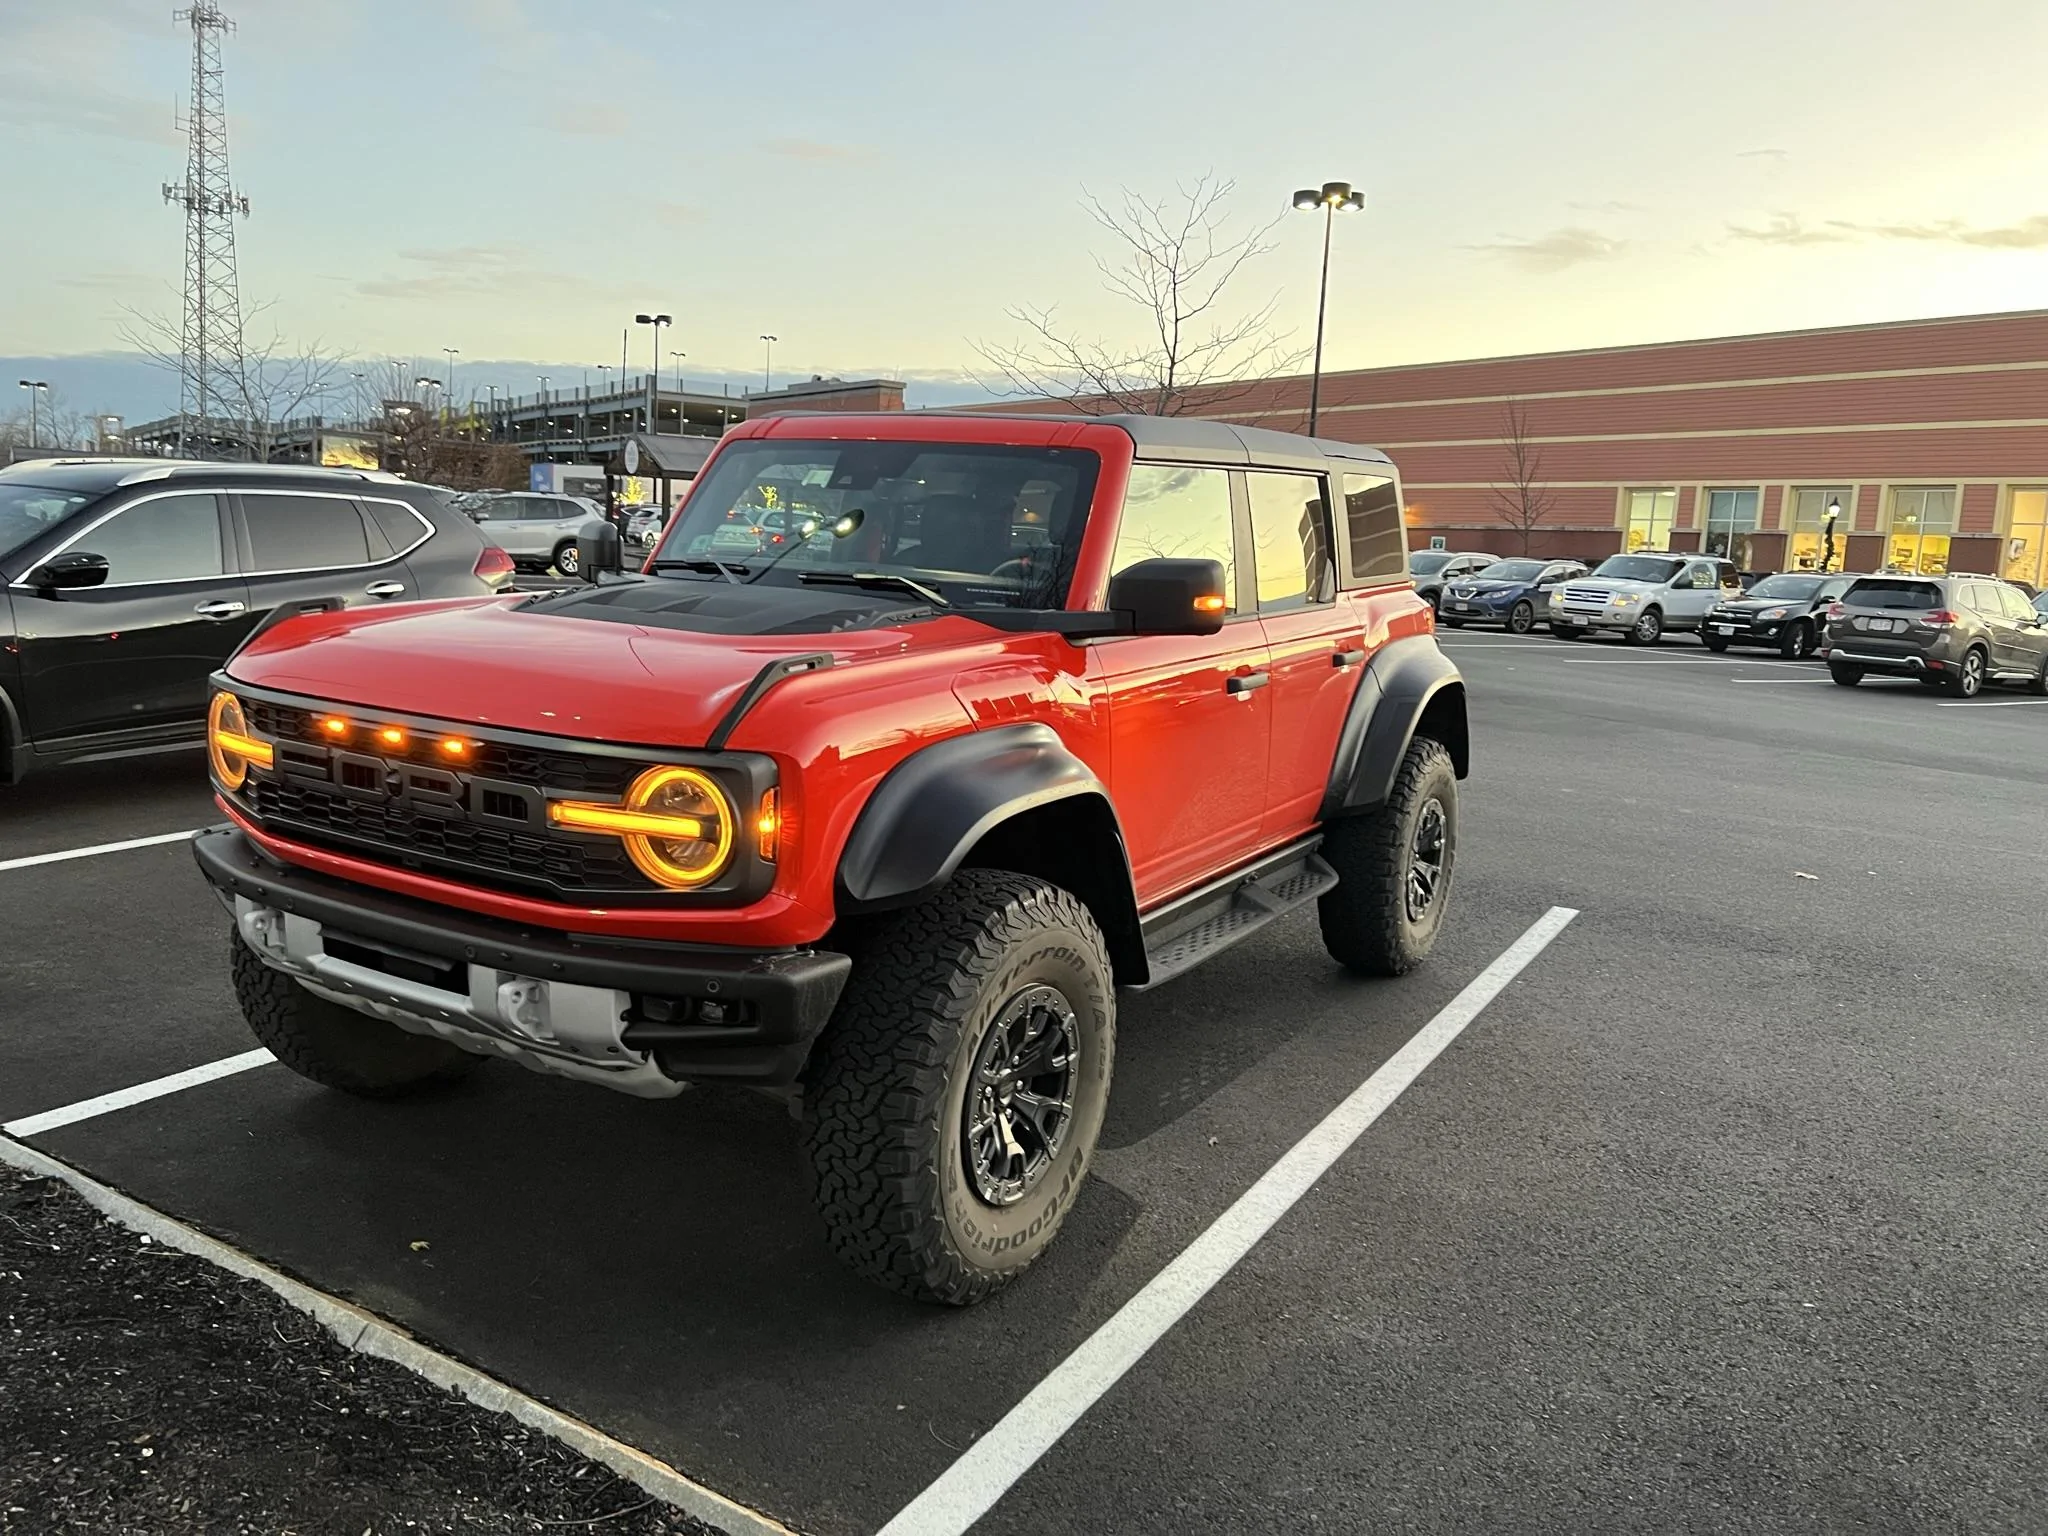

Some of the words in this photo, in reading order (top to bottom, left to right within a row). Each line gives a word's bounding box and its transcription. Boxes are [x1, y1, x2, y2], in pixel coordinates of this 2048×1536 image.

[275, 738, 544, 832] FORD
[967, 946, 1086, 1068] All-Terrain
[954, 1146, 1084, 1257] BFGoodrich
